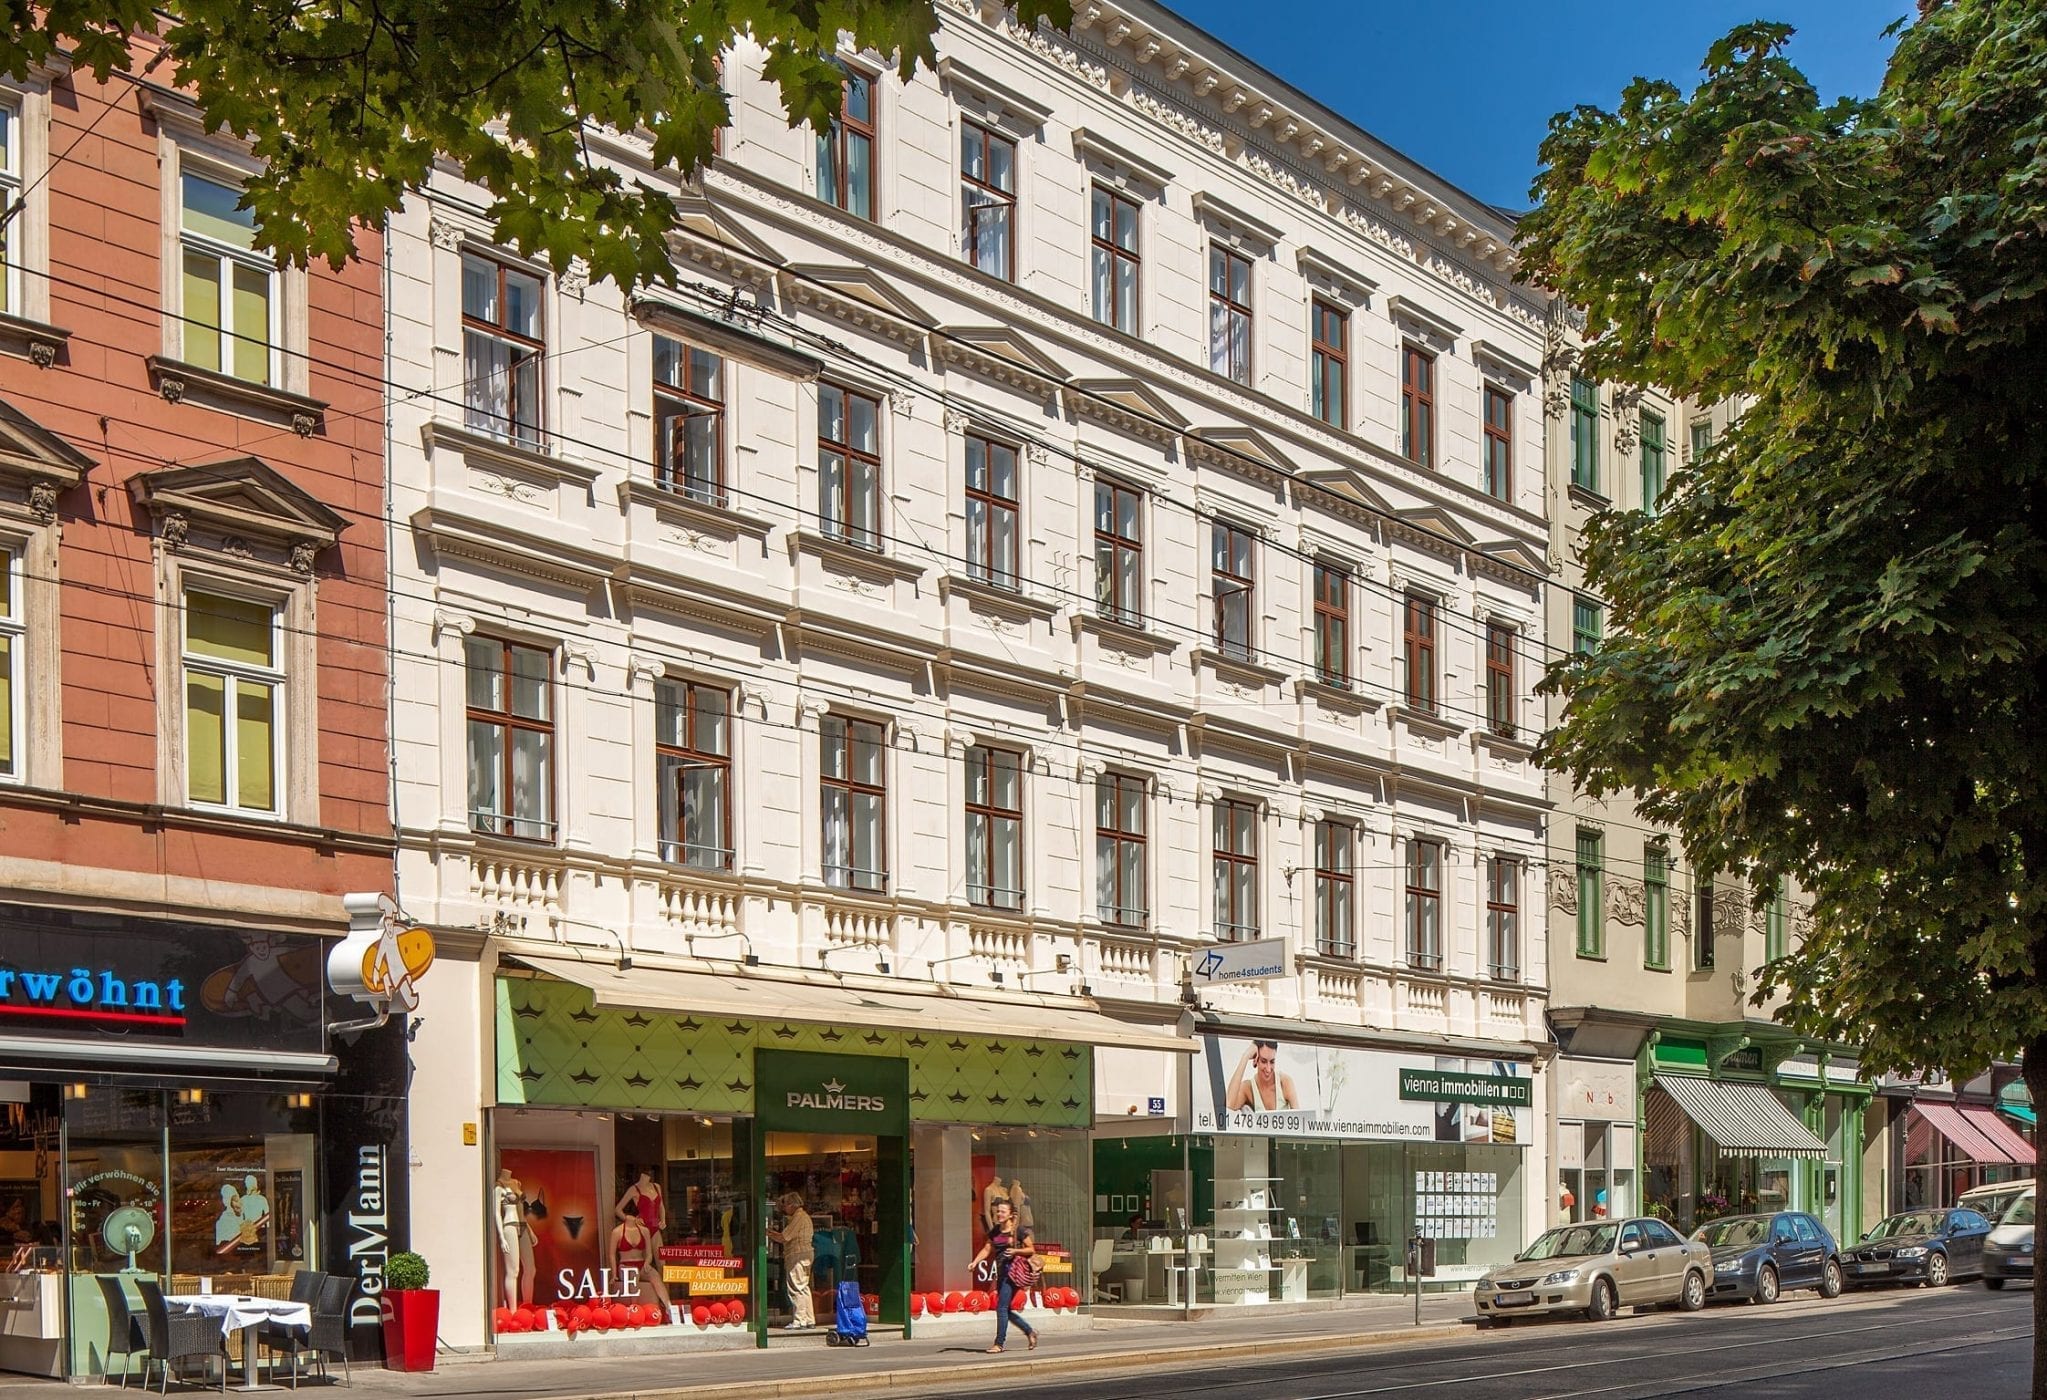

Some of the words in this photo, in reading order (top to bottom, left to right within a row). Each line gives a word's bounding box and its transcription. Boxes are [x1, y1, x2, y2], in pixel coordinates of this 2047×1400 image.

[1218, 965, 1283, 980] home4students
[1404, 1075, 1440, 1094] vienna
[1441, 1077, 1500, 1097] immobilien
[786, 1092, 885, 1112] PALMERS
[1198, 1112, 1215, 1127] tel.
[1217, 1113, 1230, 1128] 01
[1234, 1114, 1253, 1129] 478
[1256, 1115, 1269, 1129] 49
[1272, 1116, 1285, 1130] 69
[1287, 1116, 1300, 1130] 99
[1307, 1119, 1430, 1136] www.viennaimmobilien.com
[349, 1144, 388, 1329] DerMann
[660, 1248, 692, 1256] WEITERE
[694, 1249, 723, 1258] ARTIKEL
[557, 1267, 641, 1300] SALE
[664, 1269, 692, 1280] JETZT
[695, 1270, 722, 1280] AUCH
